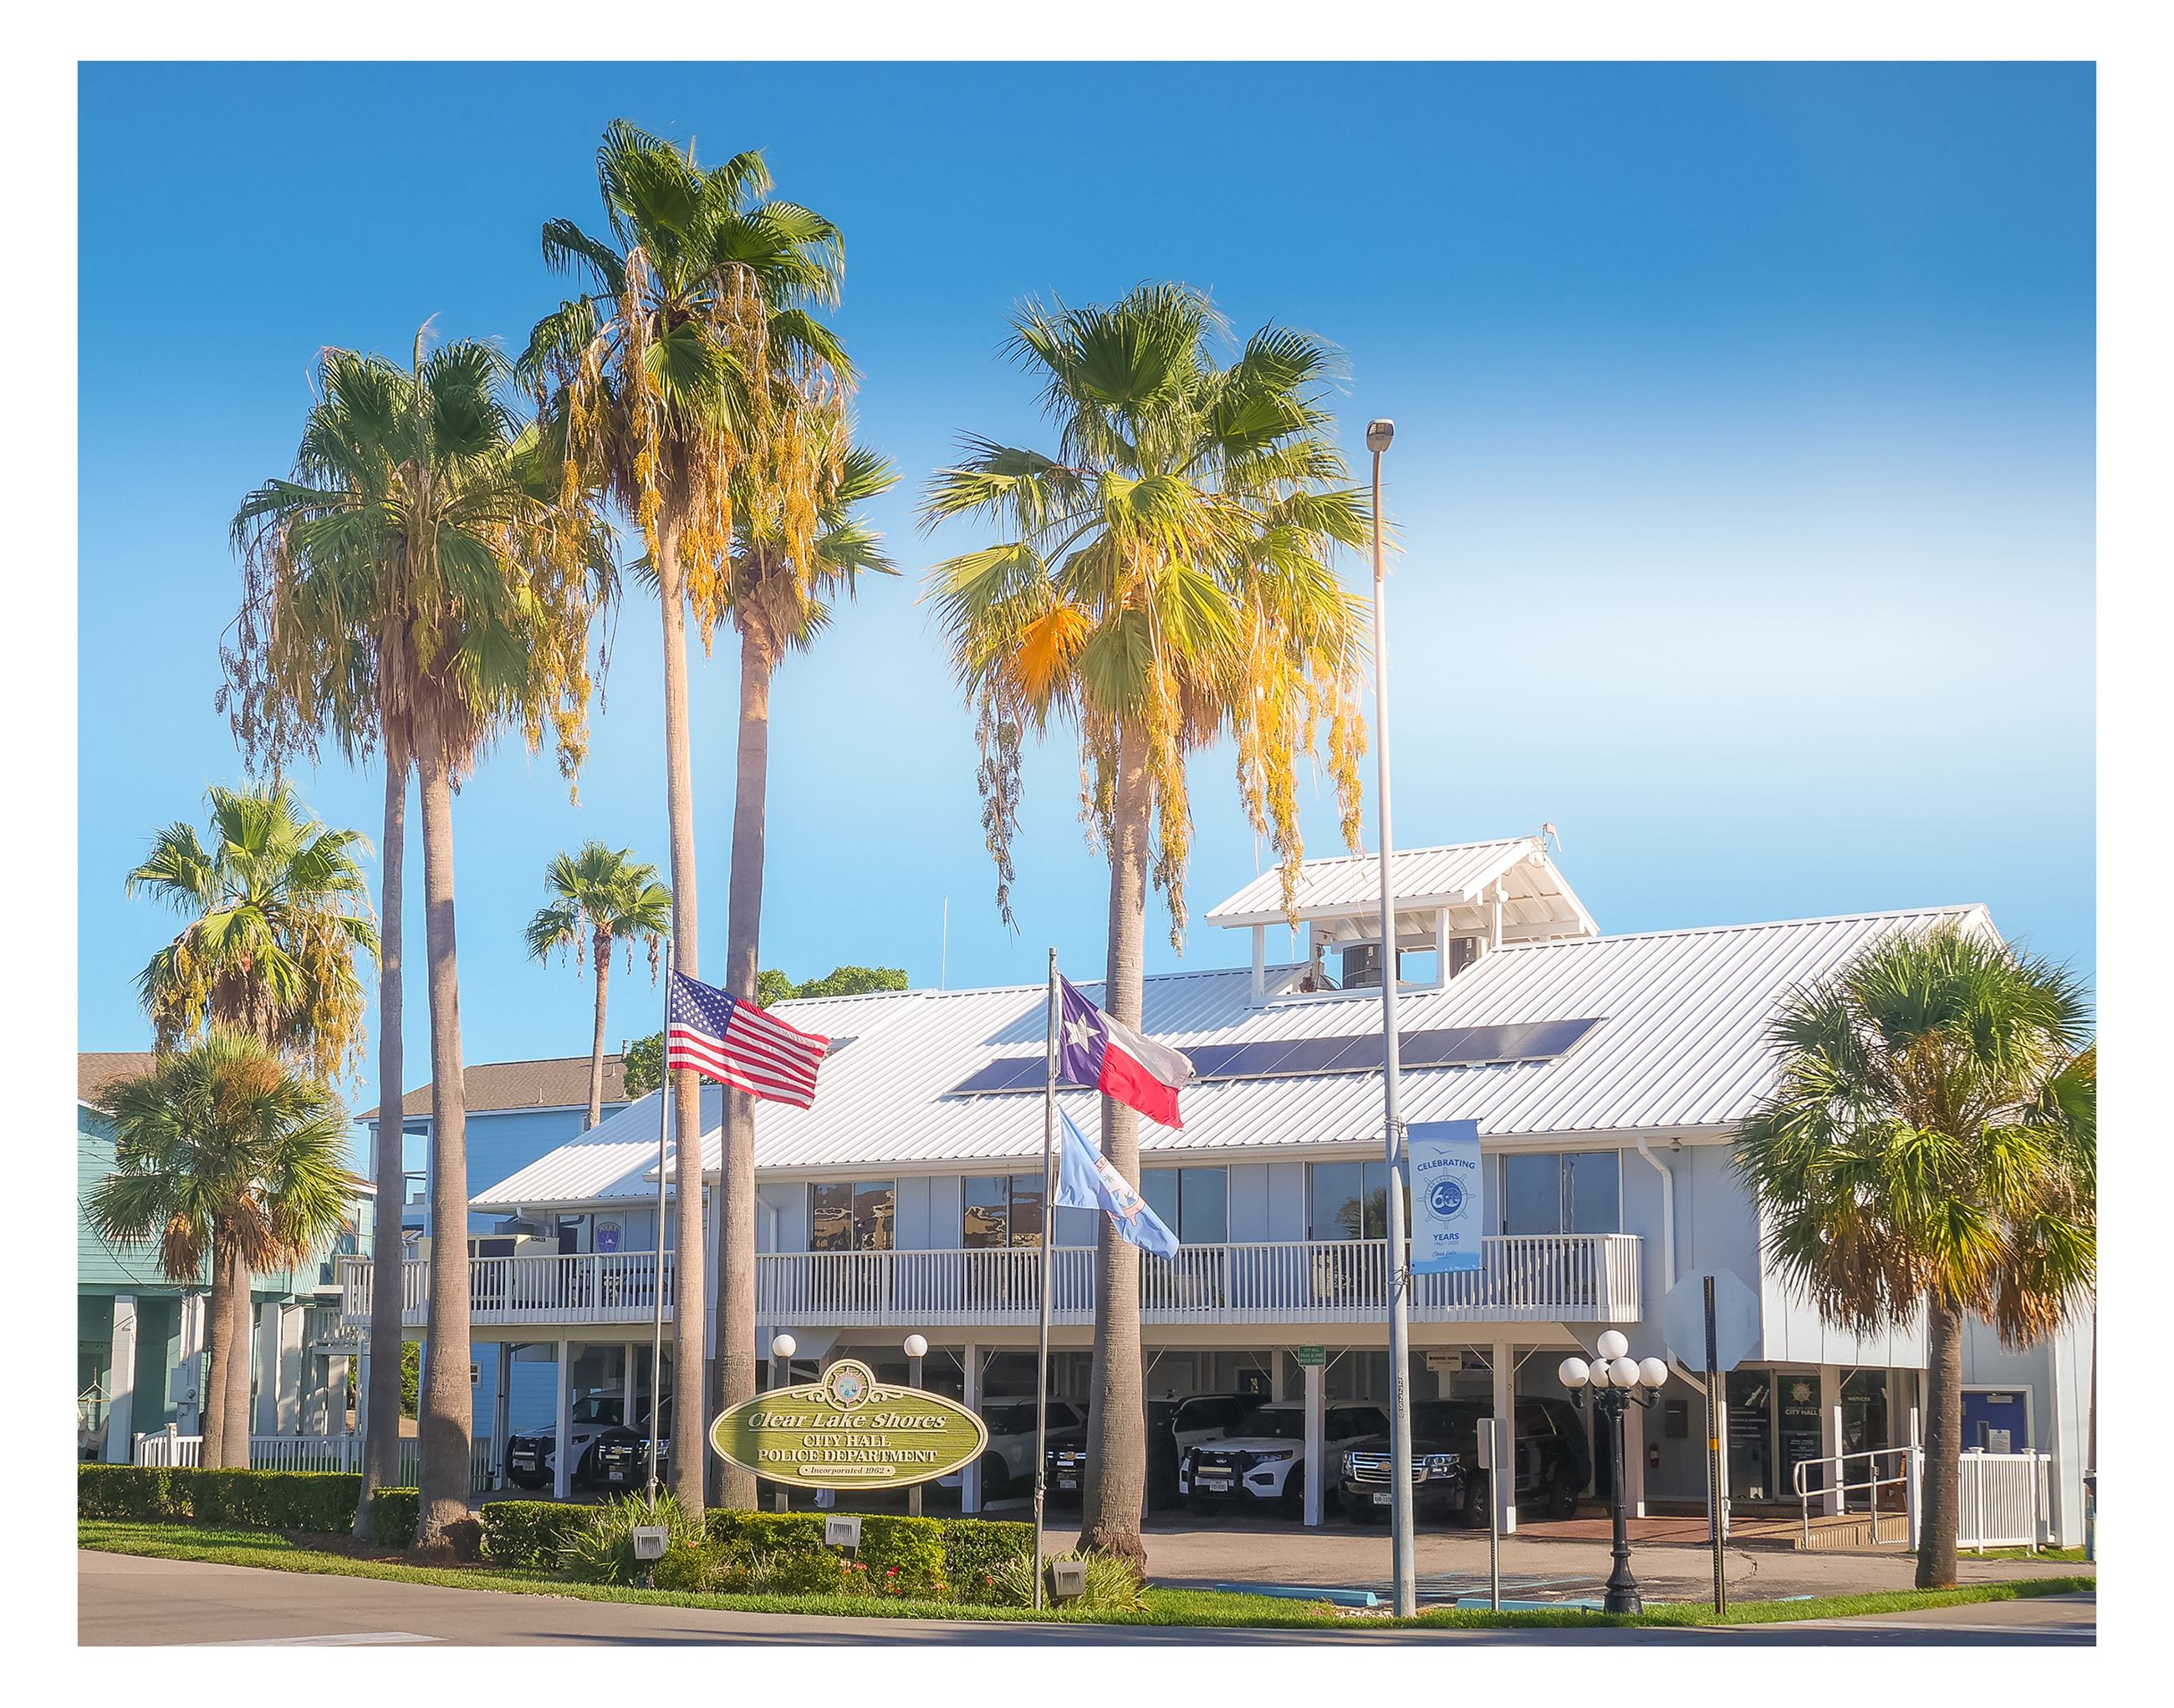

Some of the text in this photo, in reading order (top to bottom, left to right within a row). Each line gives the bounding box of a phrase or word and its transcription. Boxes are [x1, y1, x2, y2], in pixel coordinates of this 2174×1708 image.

[1417, 1159, 1476, 1171] CELEBRATING
[599, 1223, 619, 1233] POLICE
[1432, 1232, 1460, 1241] YEARS
[748, 1411, 947, 1429] Clear Lake Shores
[803, 1435, 891, 1447] CITY HALL
[757, 1449, 938, 1462] POLICE DEPARTMENT
[810, 1466, 885, 1476] Incorporated 1962
